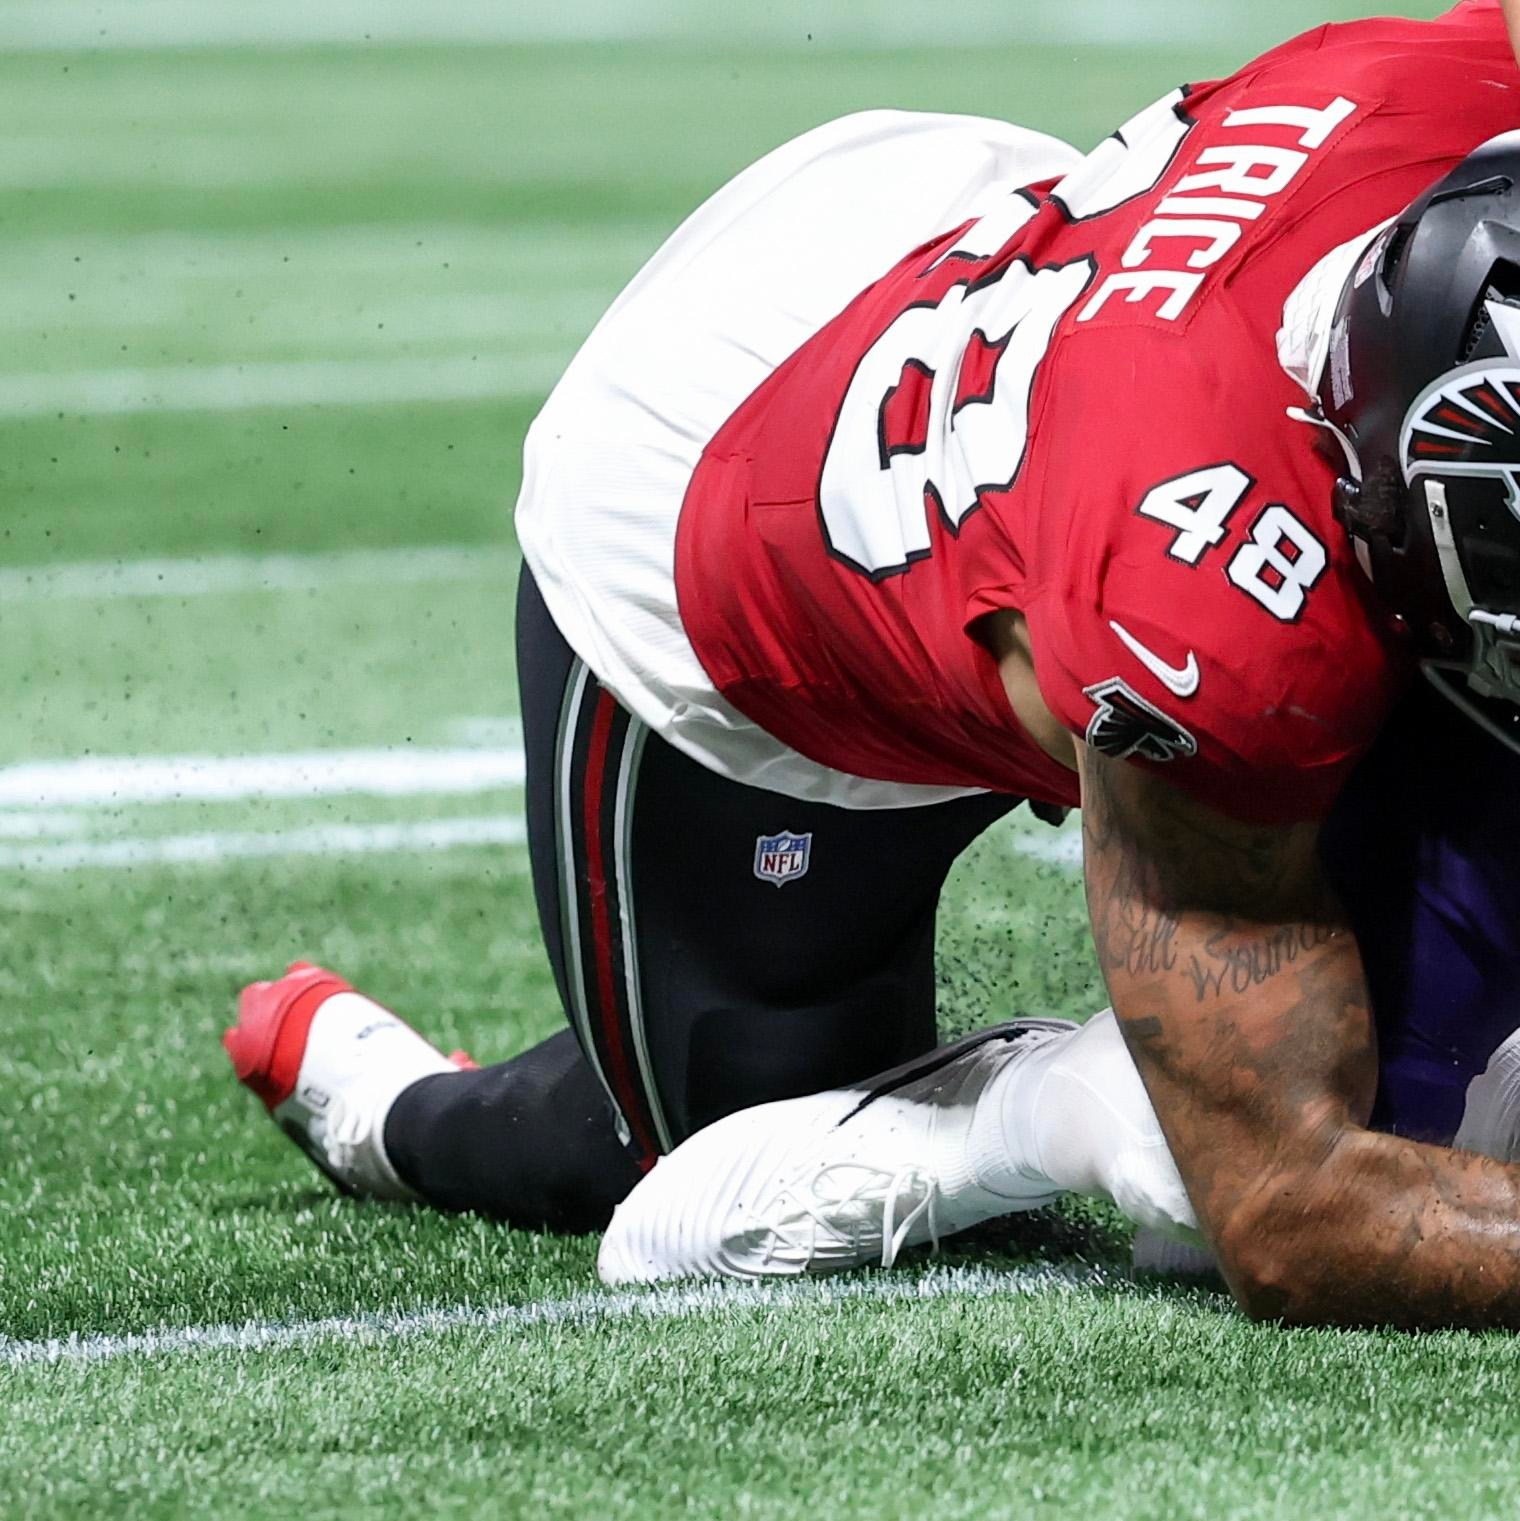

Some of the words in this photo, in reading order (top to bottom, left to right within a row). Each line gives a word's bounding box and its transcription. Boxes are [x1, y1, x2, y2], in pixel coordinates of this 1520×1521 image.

[1076, 96, 1358, 323] TRICE
[1139, 463, 1328, 623] 48
[762, 852, 801, 875] NFL
